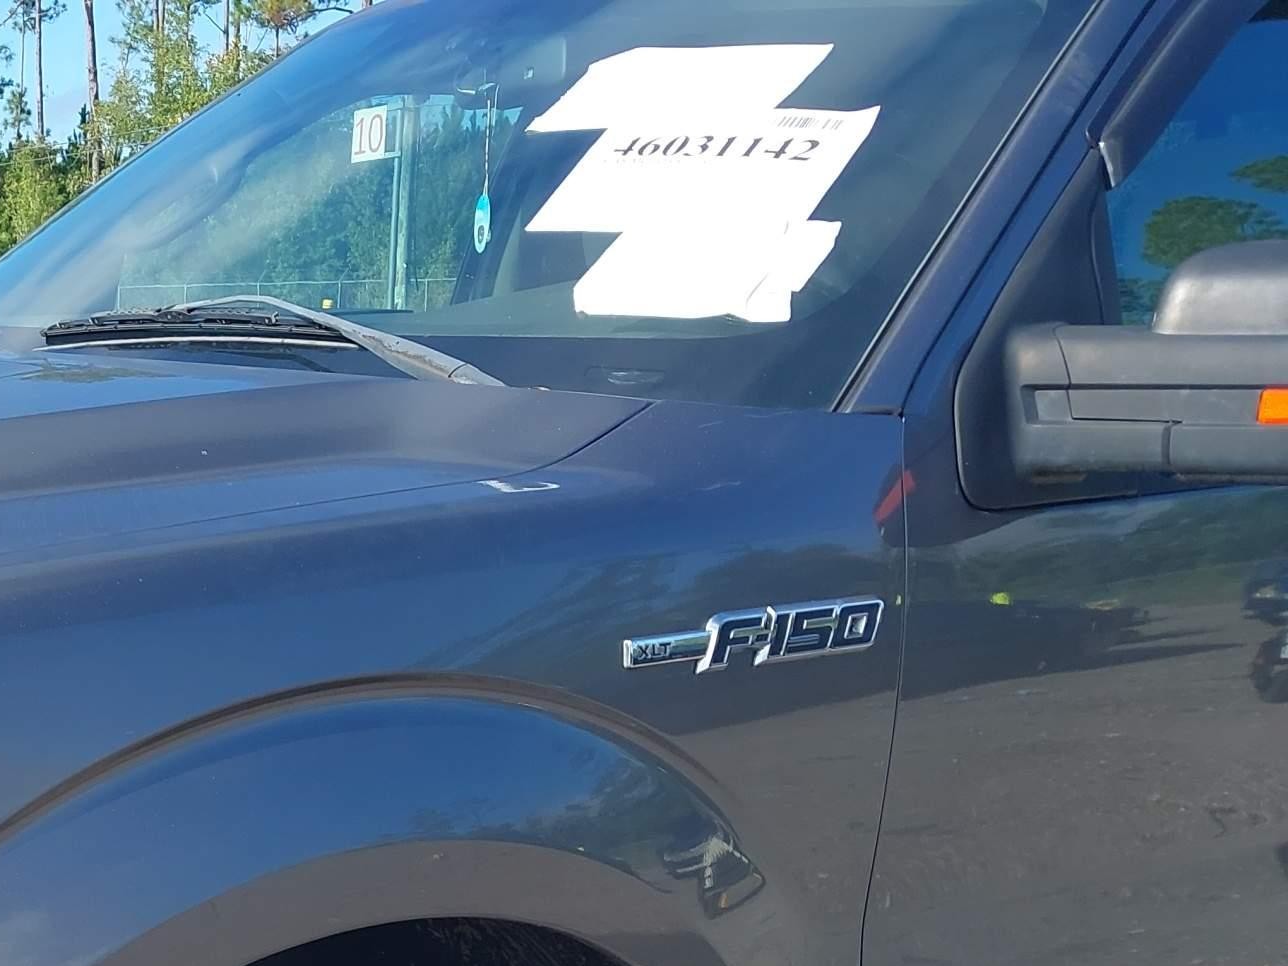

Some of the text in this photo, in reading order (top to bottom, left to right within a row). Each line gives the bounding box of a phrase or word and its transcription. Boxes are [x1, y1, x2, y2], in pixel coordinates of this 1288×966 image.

[354, 113, 384, 156] 10
[613, 135, 820, 161] 46031142
[639, 640, 672, 658] XLT
